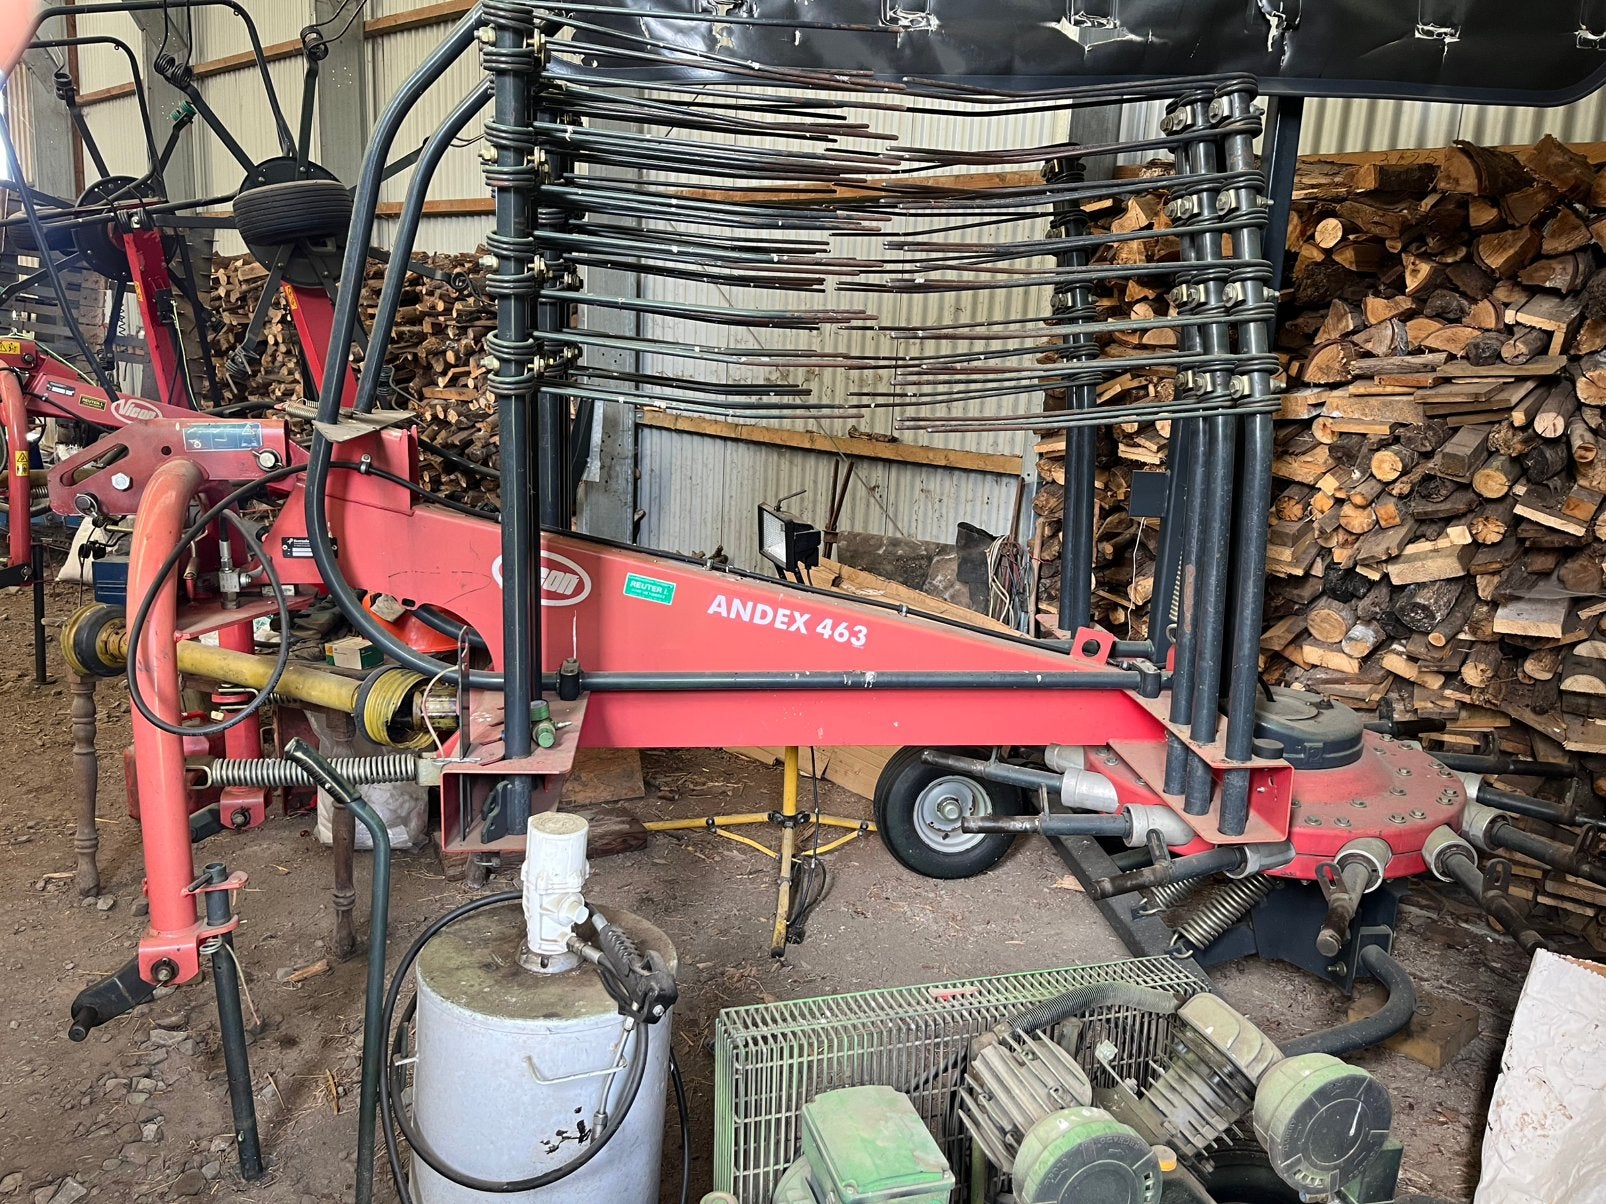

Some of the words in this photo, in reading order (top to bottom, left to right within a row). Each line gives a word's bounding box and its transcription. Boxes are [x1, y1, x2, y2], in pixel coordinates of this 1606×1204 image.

[630, 580, 663, 594] REUTER
[707, 594, 811, 635] ANDEX
[815, 618, 868, 646] 463
